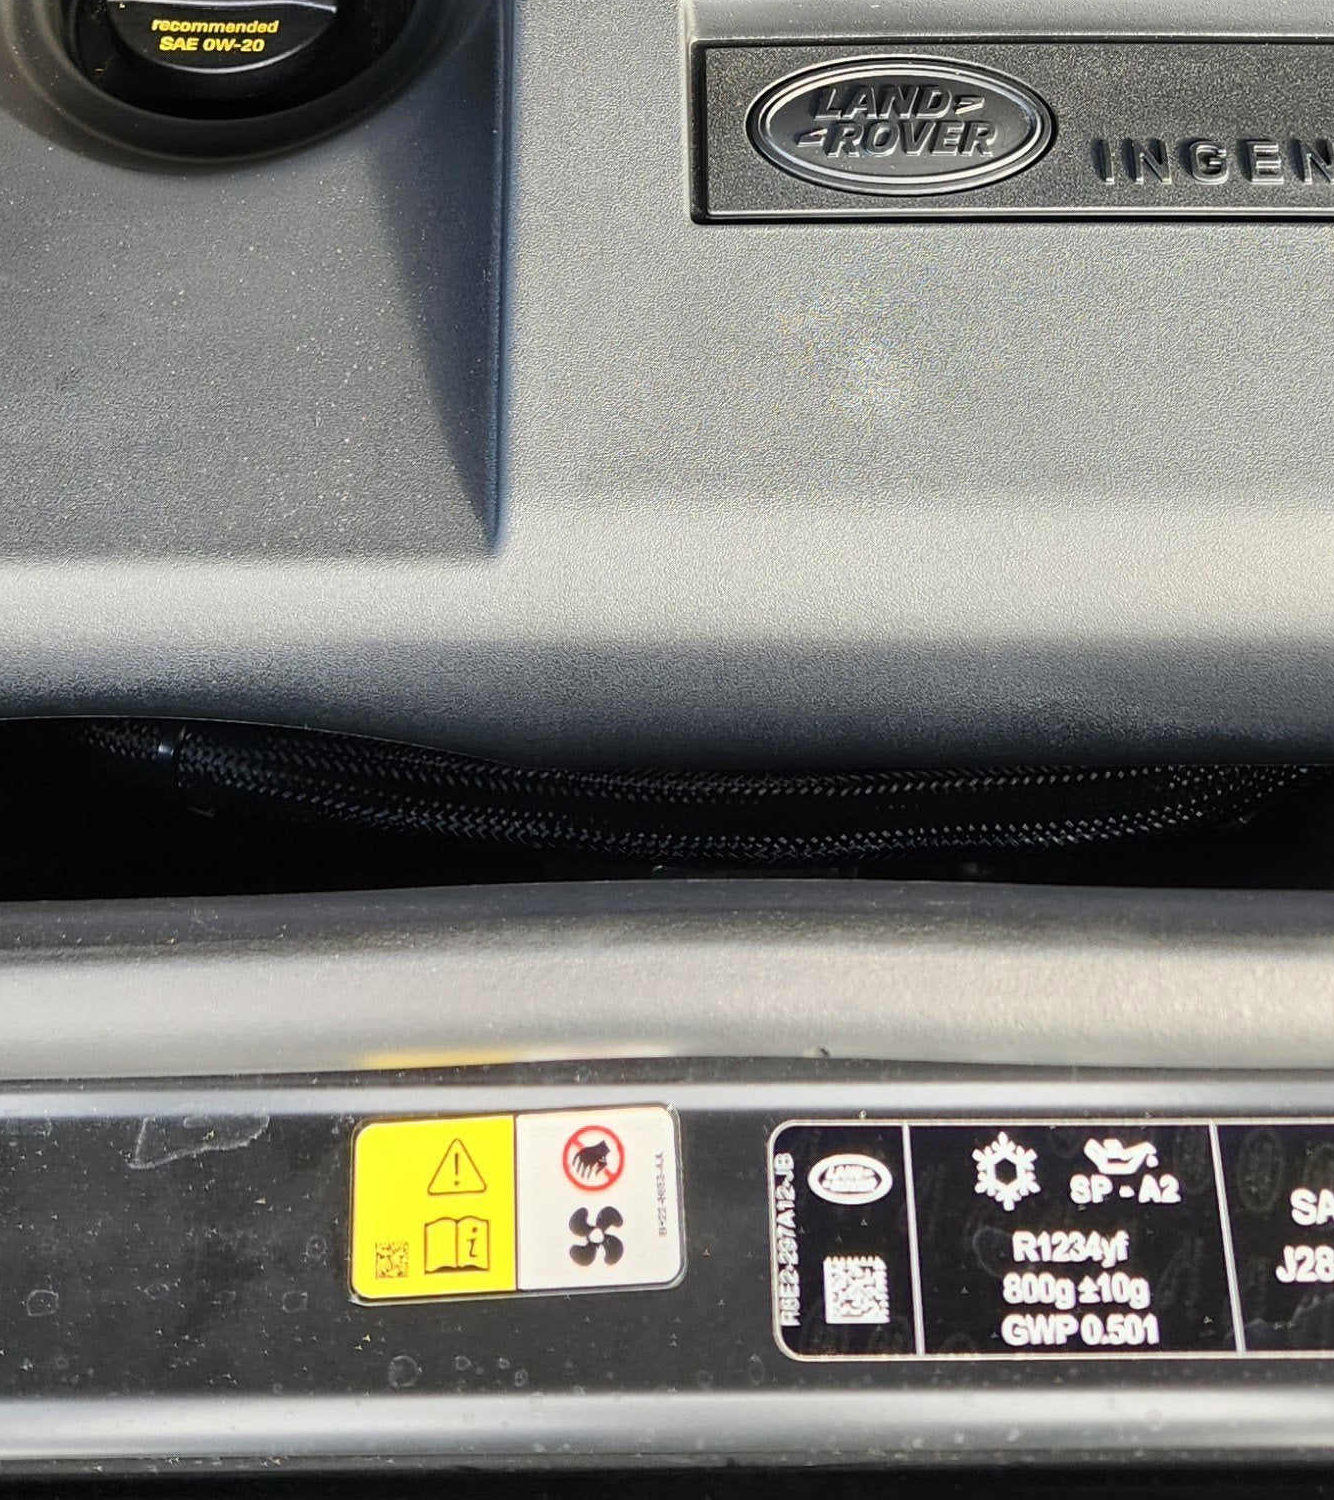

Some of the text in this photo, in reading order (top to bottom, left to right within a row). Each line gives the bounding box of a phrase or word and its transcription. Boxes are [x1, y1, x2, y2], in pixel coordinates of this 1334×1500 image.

[151, 18, 280, 34] recommended
[159, 36, 265, 52] SAE 0W-20
[813, 85, 954, 120] LAND
[827, 121, 998, 158] ROVER
[1012, 1230, 1130, 1268] R1234yf
[1002, 1272, 1076, 1310] 800g
[1001, 1313, 1160, 1346] GWP 0.501
